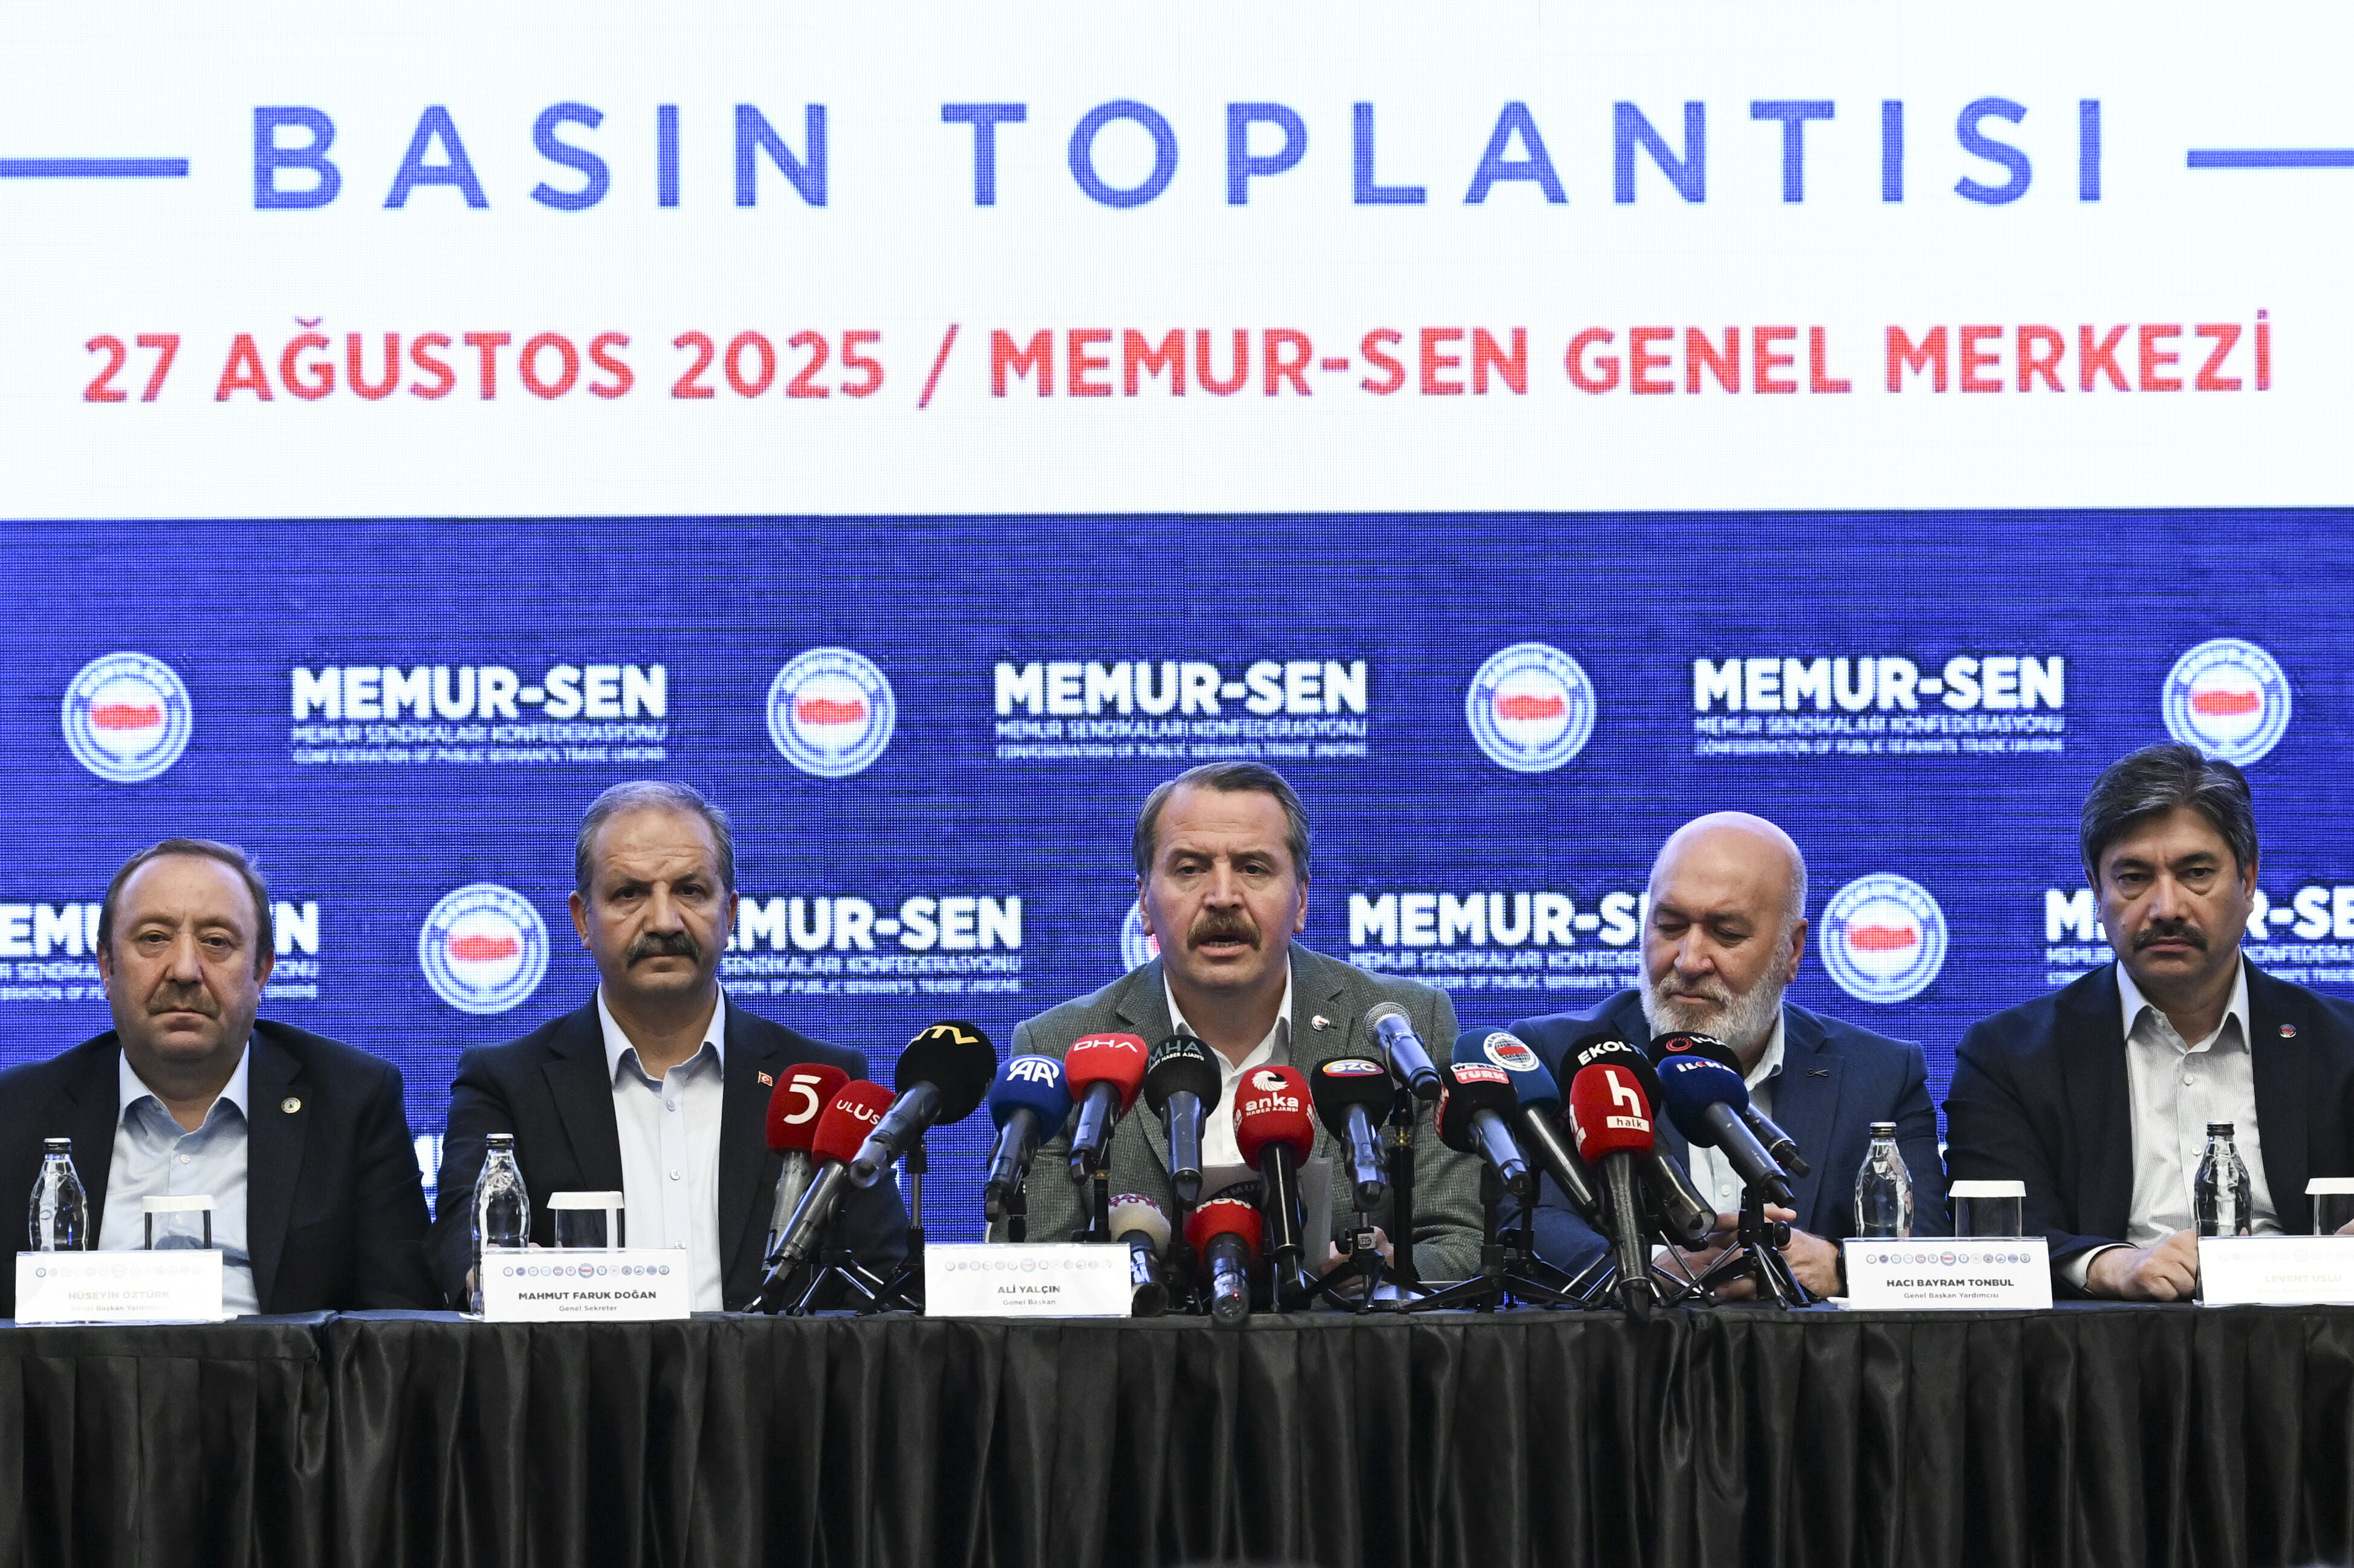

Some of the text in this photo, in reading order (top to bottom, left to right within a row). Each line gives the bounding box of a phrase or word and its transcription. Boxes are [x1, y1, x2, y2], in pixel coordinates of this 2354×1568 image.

[254, 98, 2101, 210] BASIN TOPLANTISI
[85, 309, 2270, 408] 27 AĞUSTOS 2025 / MEMUR-SEN GENEL MERKEZİ
[291, 665, 666, 720] MEMUR-SEN
[994, 661, 1367, 716] MEMUR-SEN
[1694, 656, 2064, 711] MEMUR-SEN
[728, 896, 1023, 951] MUR-SEN
[1349, 892, 1649, 946] MEMUR-S
[1073, 1040, 1138, 1053] DHA
[1149, 1040, 1203, 1068] MHA
[1578, 1041, 1632, 1066] EKOL
[1006, 1059, 1057, 1088] AA
[1332, 1063, 1377, 1072] SZC
[783, 1074, 822, 1124] 5
[1245, 1092, 1299, 1112] anka
[1605, 1070, 1642, 1118] h
[836, 1100, 881, 1125] ULUS
[1247, 1107, 1271, 1117] HABER
[1616, 1117, 1643, 1129] halk
[68, 1289, 170, 1300] HÜSEYİN ÖZTÜRK
[518, 1289, 657, 1300] MAHMUT FARUK DOĞAN
[997, 1284, 1061, 1295] ALİ YALÇIN
[1886, 1278, 2015, 1287] HACI BAYRAM TONBUL
